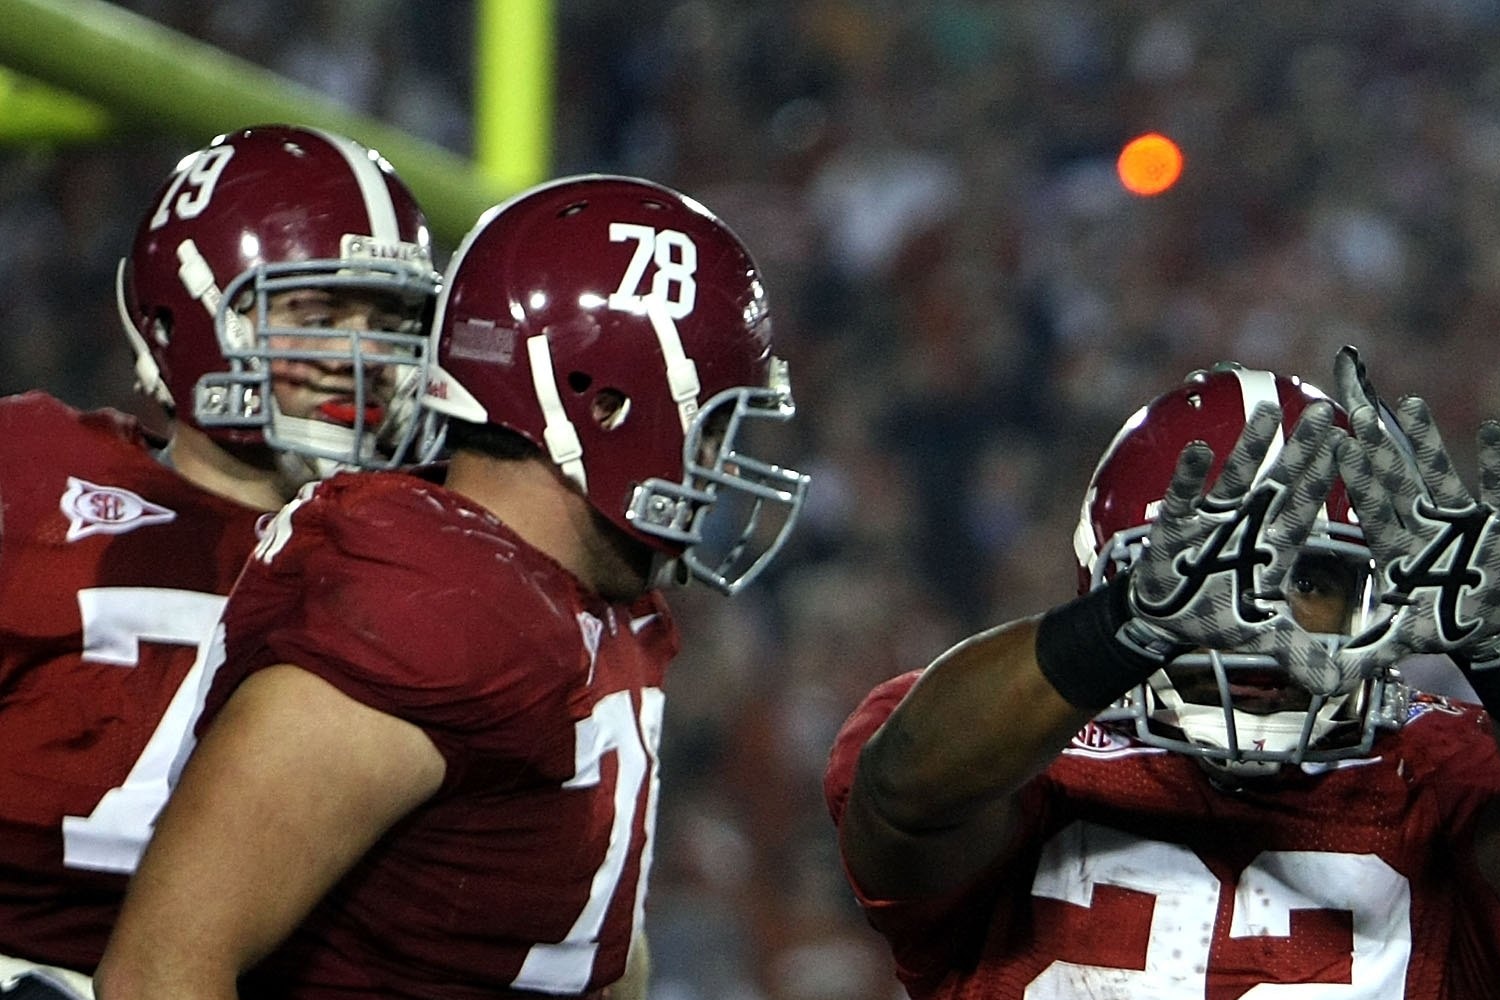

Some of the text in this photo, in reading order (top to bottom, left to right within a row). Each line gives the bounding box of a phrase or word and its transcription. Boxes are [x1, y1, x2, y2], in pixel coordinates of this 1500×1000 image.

[150, 144, 236, 231] 79
[608, 222, 697, 321] 78
[89, 493, 125, 521] SEC
[510, 687, 666, 995] 7
